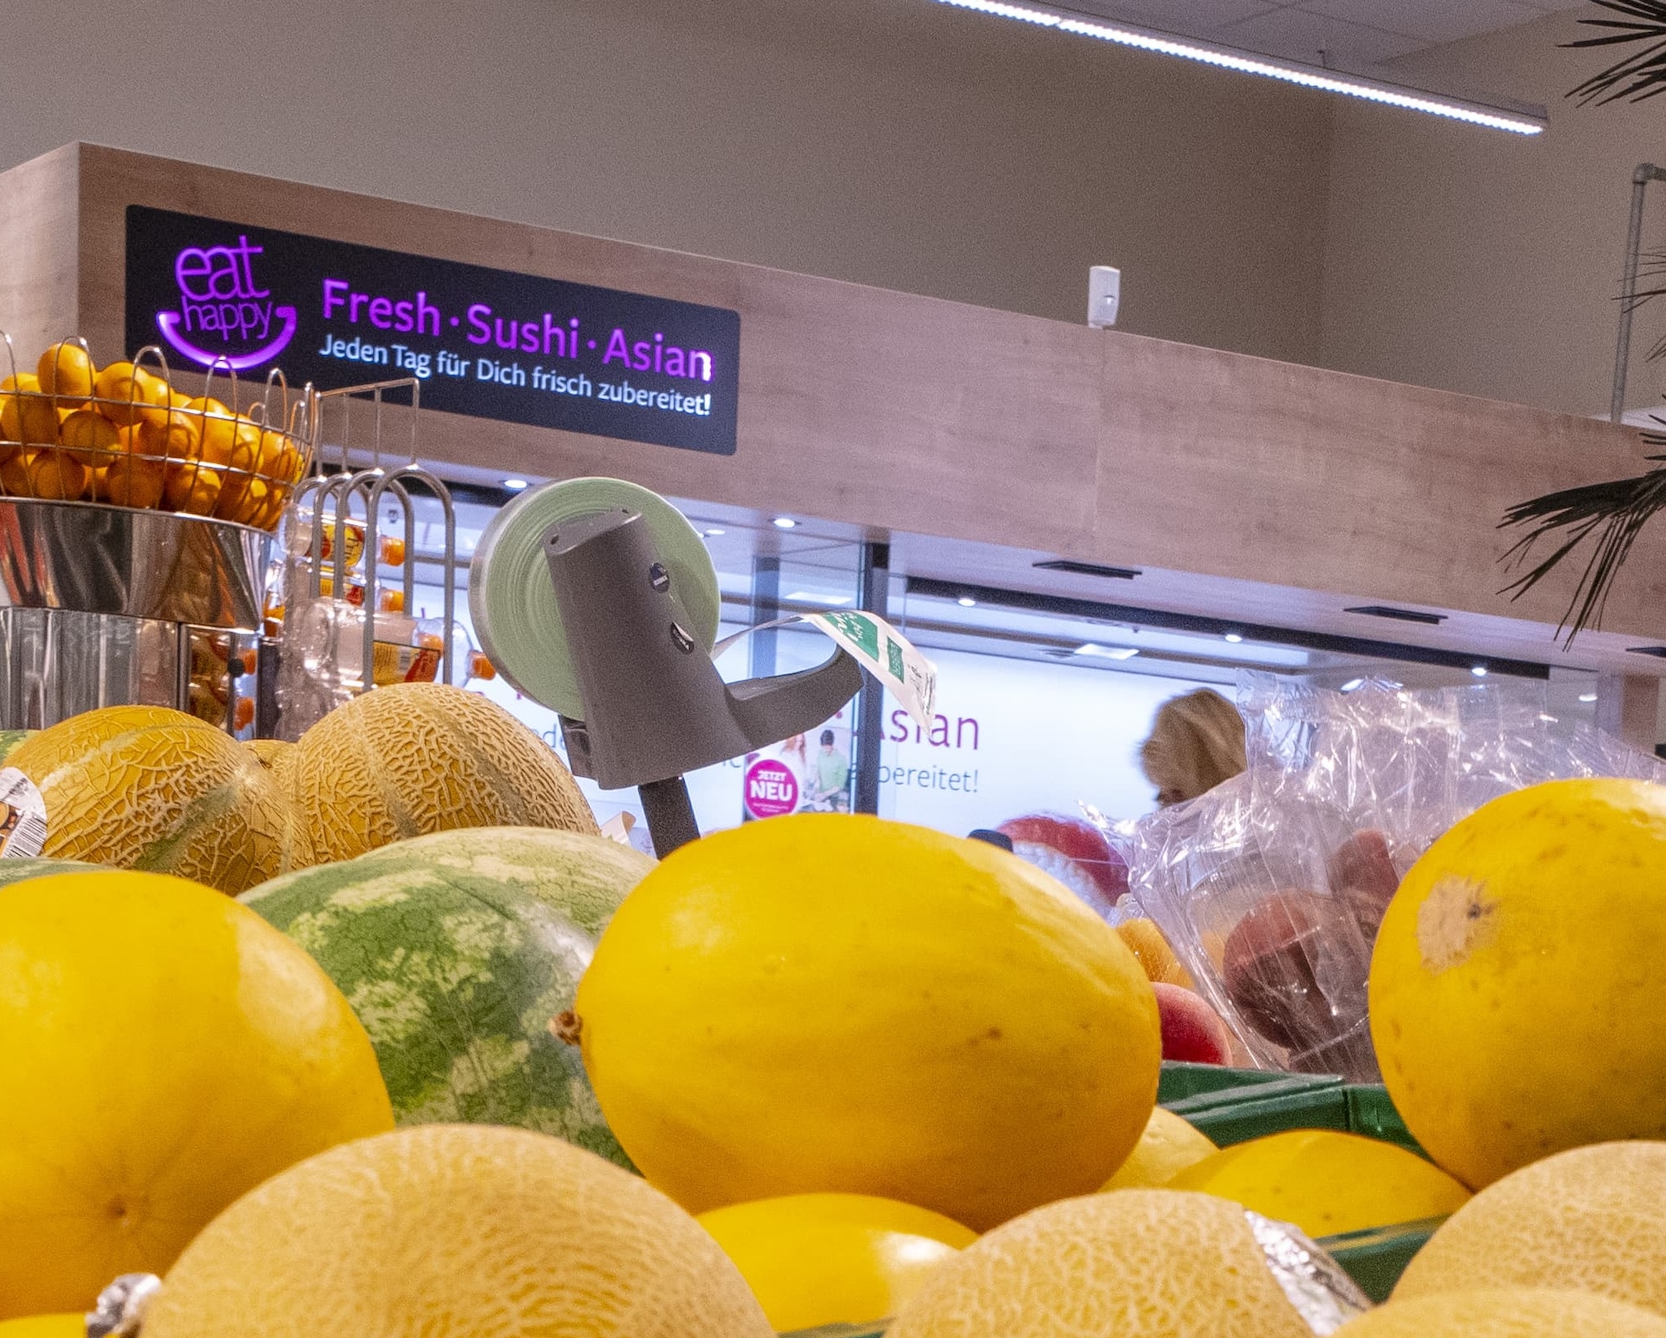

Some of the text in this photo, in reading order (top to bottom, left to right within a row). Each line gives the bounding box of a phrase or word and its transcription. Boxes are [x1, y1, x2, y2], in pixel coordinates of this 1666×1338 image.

[175, 235, 271, 300] eat
[182, 295, 273, 341] happy
[322, 278, 713, 383] Fresh Sushi Asian
[319, 334, 711, 416] Jeden Tag für Dich frisch zubereitet!
[750, 779, 793, 802] NEU
[757, 770, 787, 782] JETZT
